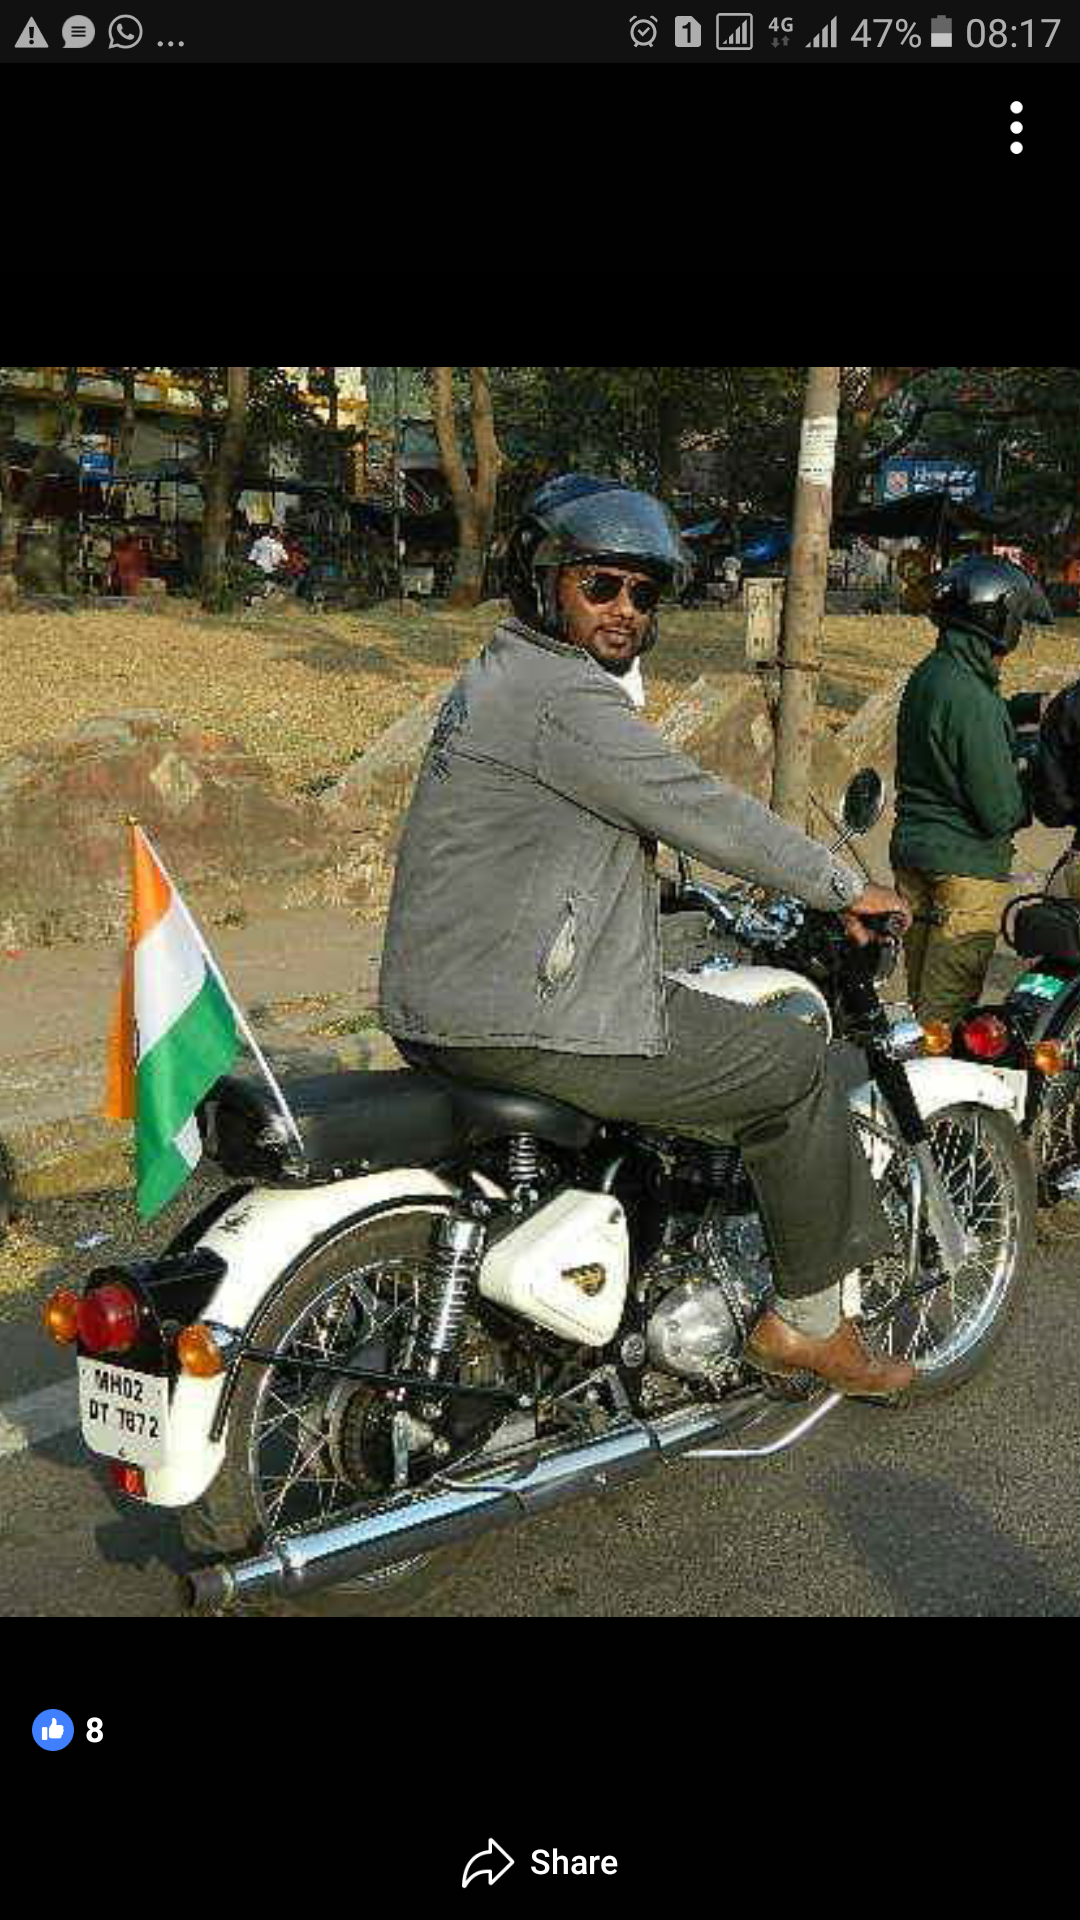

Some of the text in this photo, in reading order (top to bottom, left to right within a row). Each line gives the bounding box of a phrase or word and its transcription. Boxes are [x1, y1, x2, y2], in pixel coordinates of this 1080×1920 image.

[95, 1369, 144, 1403] MH02
[89, 1399, 159, 1438] DT 7872
